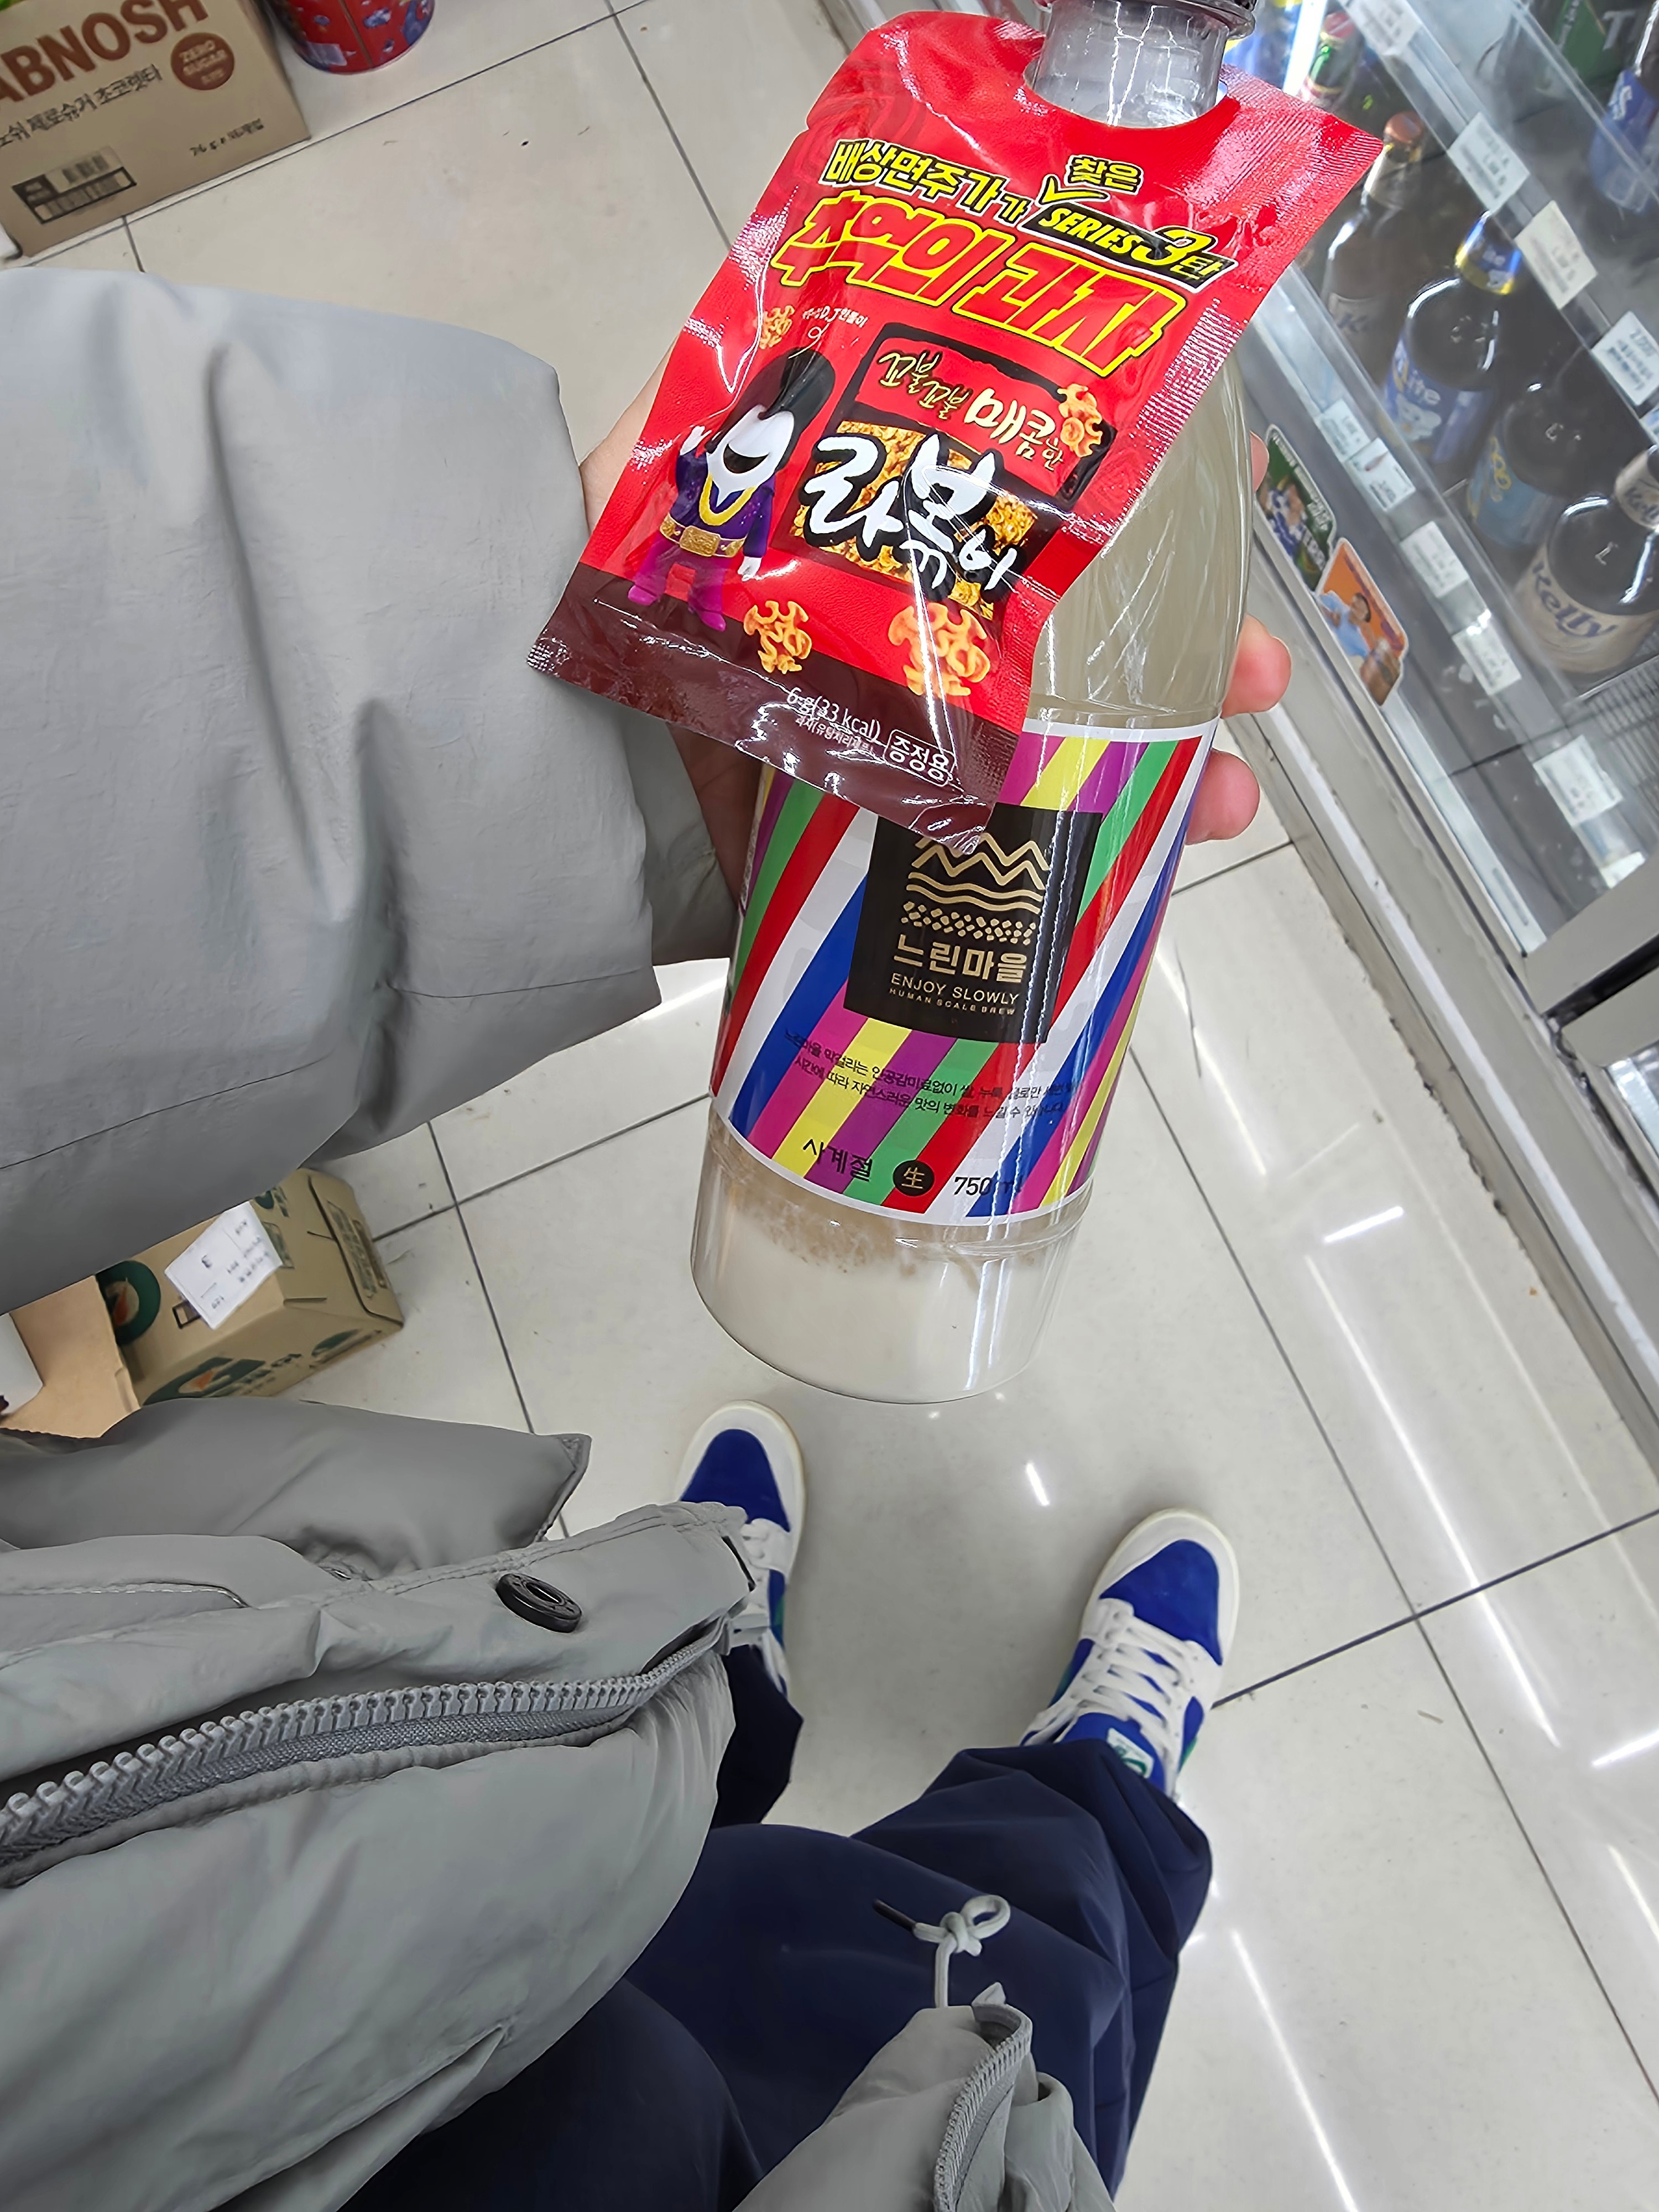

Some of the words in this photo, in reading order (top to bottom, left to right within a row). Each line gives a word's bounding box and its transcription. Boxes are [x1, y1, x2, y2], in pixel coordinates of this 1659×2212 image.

[1070, 157, 1140, 192] 찾은
[964, 388, 1063, 471] 매콤한
[801, 432, 1020, 593] 라볶이
[1532, 559, 1619, 638] Kelly
[889, 735, 950, 782] 증정용
[894, 933, 1027, 984] 느린마을
[889, 988, 931, 1004] HUMAN
[936, 999, 976, 1011] SCALE
[891, 972, 947, 995] ENJOY
[952, 987, 1019, 1005] SLOWLY
[915, 1097, 941, 1114] 맛의
[802, 1138, 873, 1182] 사계절
[901, 1167, 925, 1190] 生
